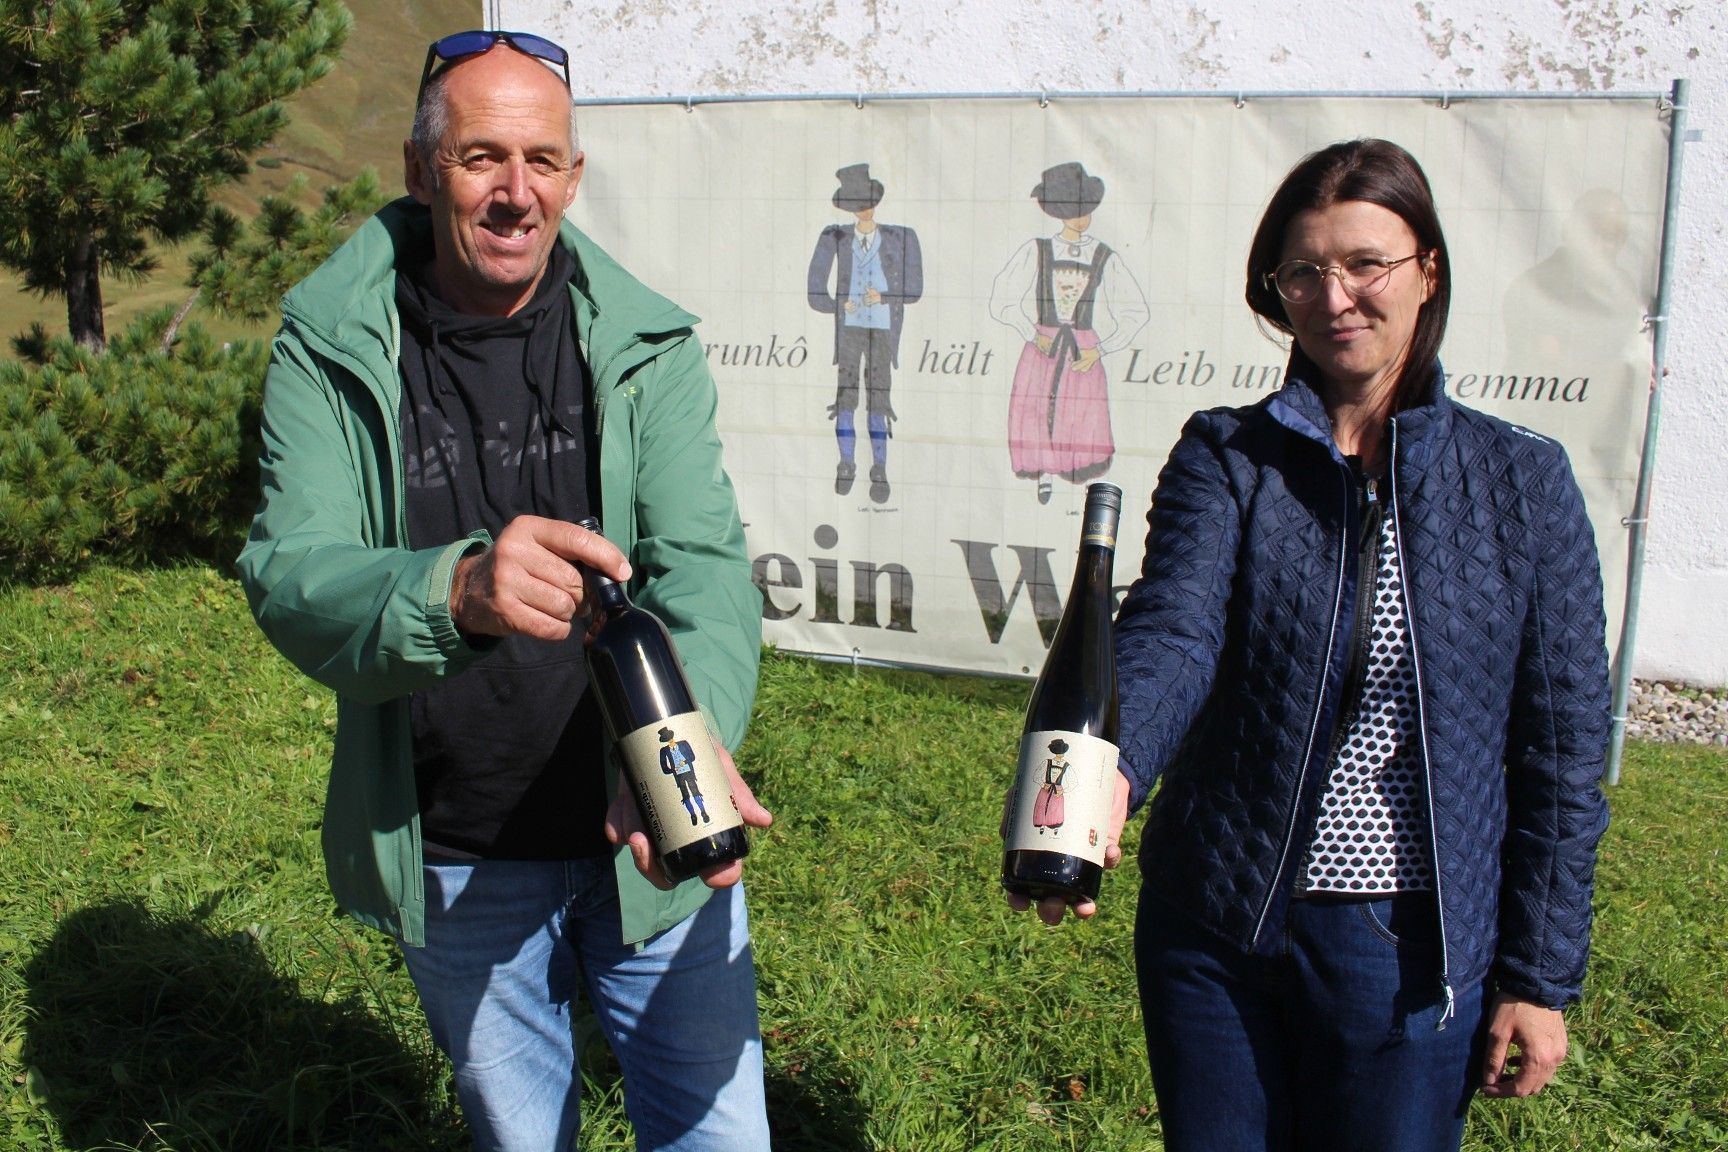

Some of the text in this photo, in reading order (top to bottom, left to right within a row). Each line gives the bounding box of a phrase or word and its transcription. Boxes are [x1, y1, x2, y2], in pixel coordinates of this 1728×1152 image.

[918, 339, 995, 376] hält
[1122, 348, 1215, 387] Leib
[742, 523, 918, 633] ein
